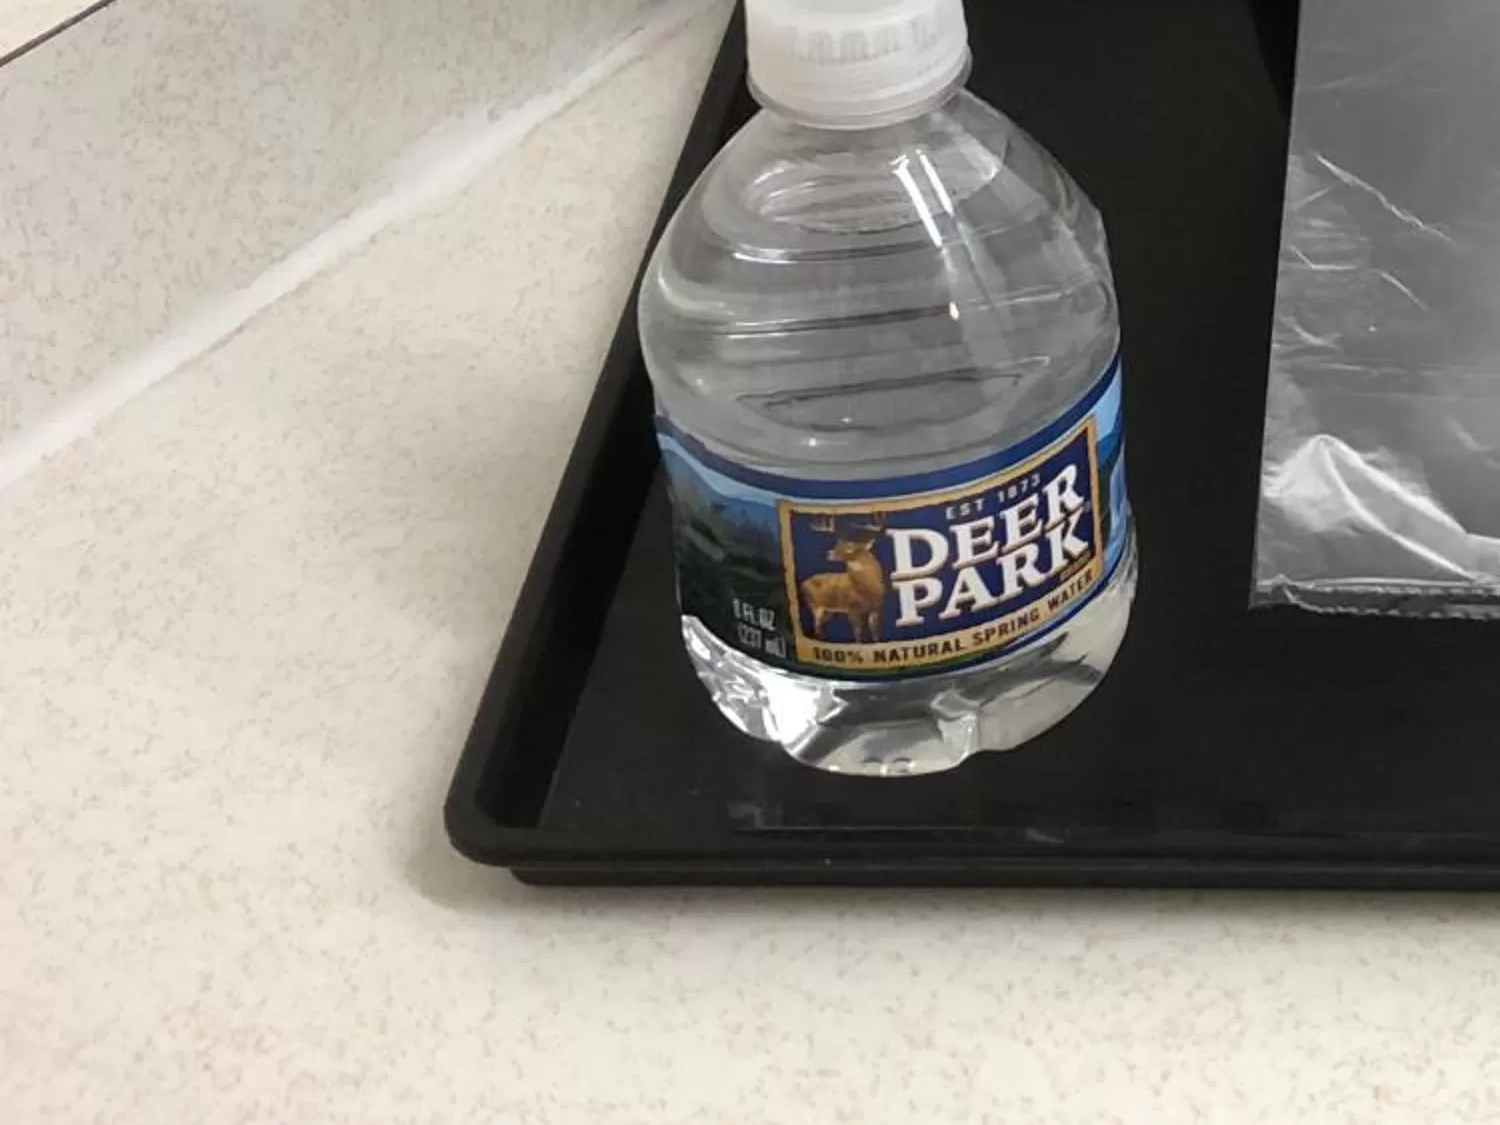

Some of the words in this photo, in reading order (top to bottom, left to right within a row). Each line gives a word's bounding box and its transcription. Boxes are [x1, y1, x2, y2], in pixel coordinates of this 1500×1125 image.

[886, 464, 1085, 580] DEER
[945, 498, 985, 520] EST
[998, 472, 1041, 503] 1873
[813, 646, 864, 664] 100%
[873, 638, 966, 662] NATURAL
[972, 608, 1041, 645] SPRING
[1048, 567, 1094, 610] WATER
[891, 506, 1089, 627] PARK
